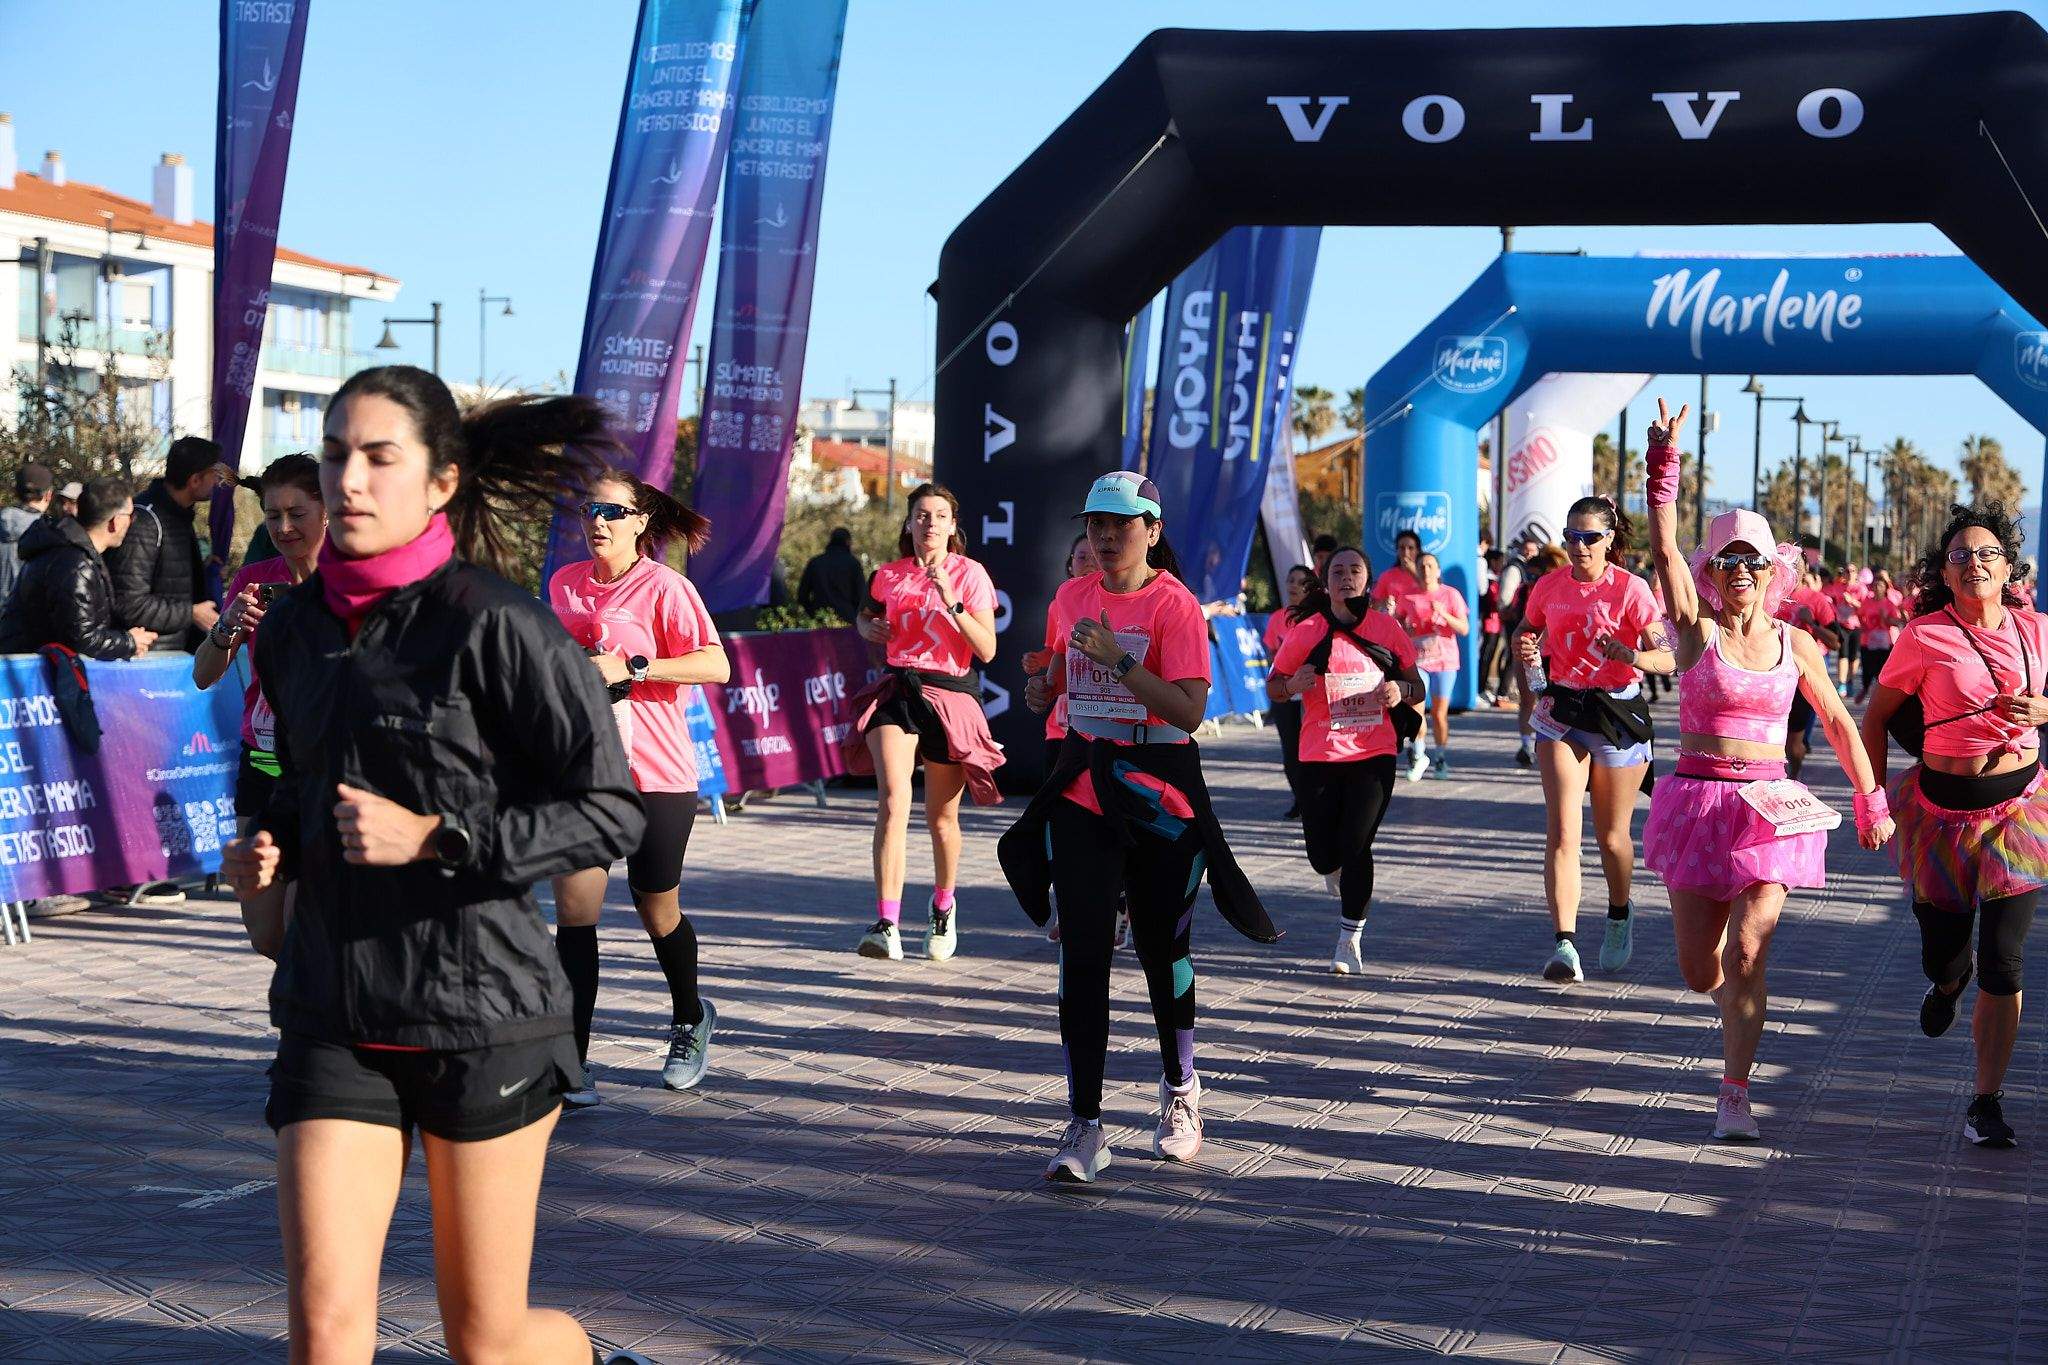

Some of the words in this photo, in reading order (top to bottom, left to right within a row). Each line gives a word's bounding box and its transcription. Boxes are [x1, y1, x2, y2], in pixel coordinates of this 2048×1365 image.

[1266, 87, 1865, 144] VOLVO
[1646, 267, 1862, 360] Marlene
[1168, 290, 1213, 449] GOYA
[1438, 348, 1502, 378] Marlene
[1342, 697, 1366, 707] 016
[42, 778, 96, 813] MAMA
[1784, 797, 1812, 810] 016
[0, 821, 96, 866] ETASTÁSICO
